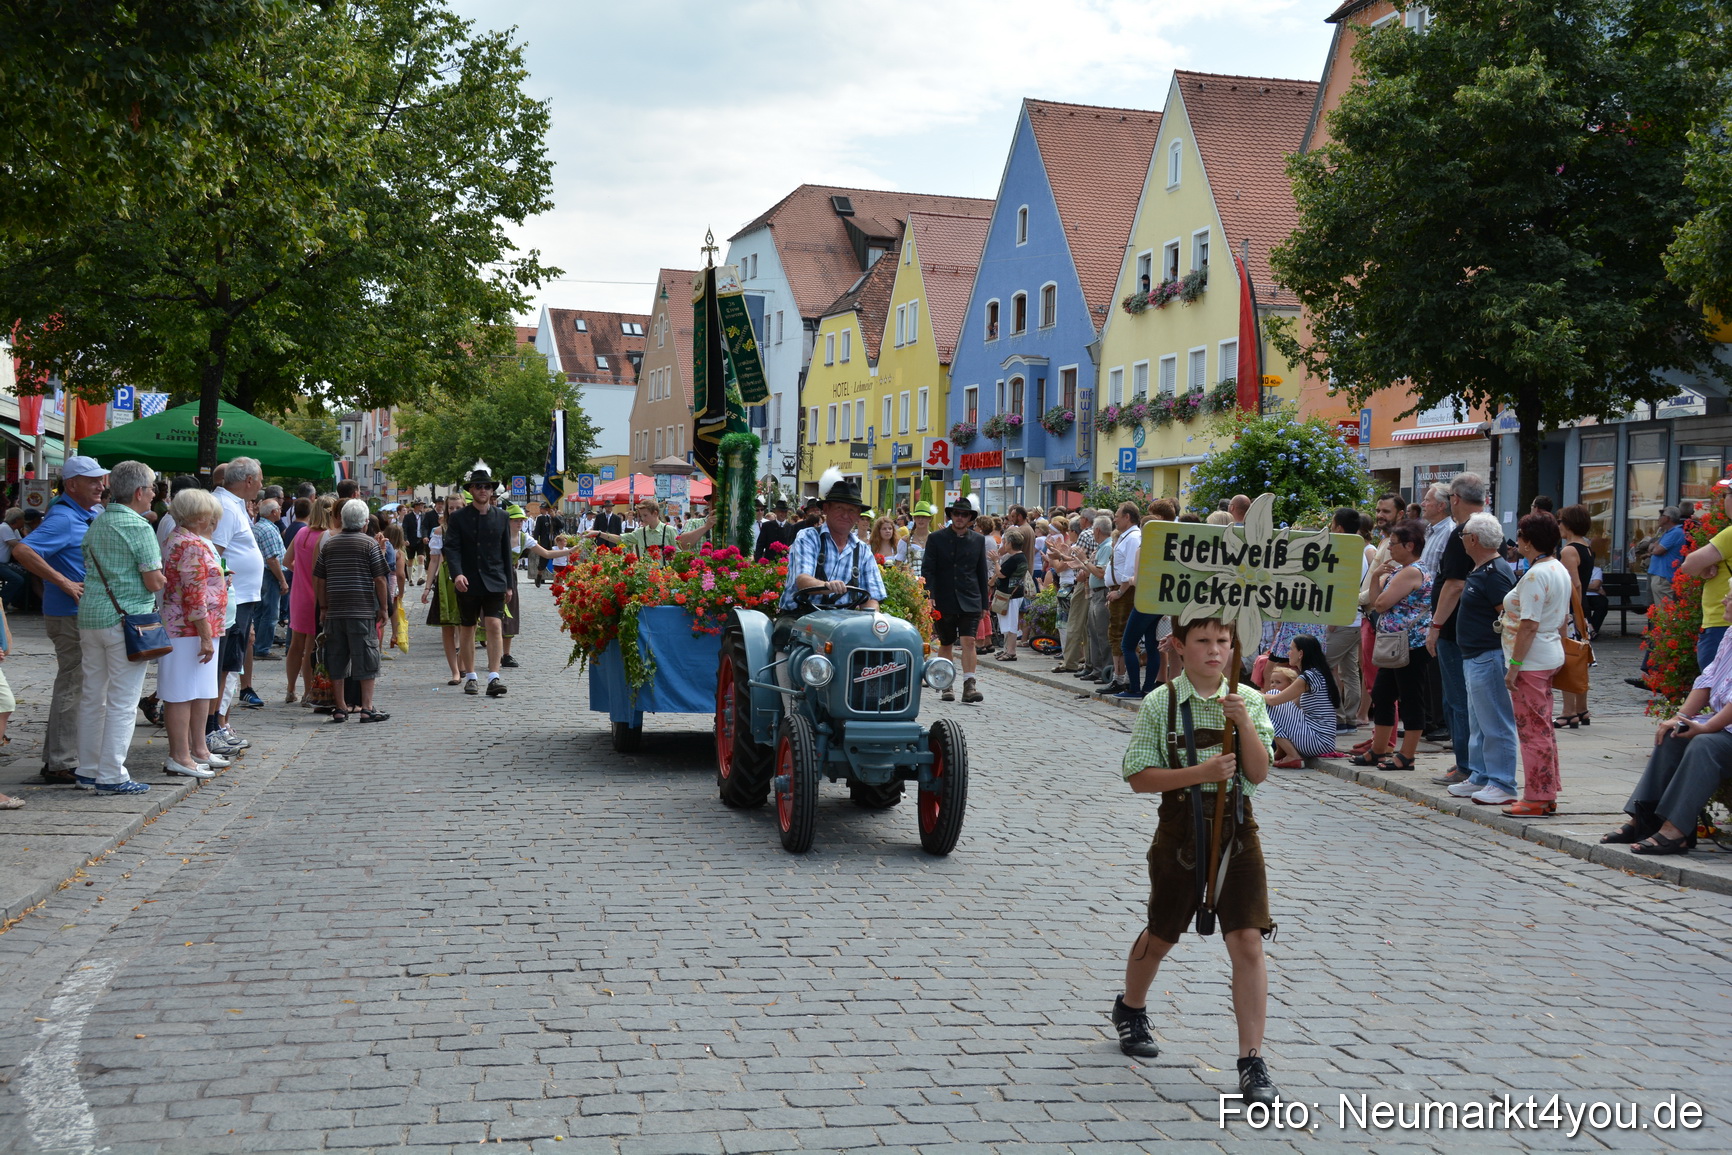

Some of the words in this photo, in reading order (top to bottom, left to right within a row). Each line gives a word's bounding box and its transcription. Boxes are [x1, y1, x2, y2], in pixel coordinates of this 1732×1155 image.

[118, 388, 129, 406] P
[832, 381, 850, 398] HOTEL
[853, 379, 874, 394] Lehmeier
[155, 433, 257, 447] Lambräu
[171, 428, 245, 438] Neukter
[959, 450, 1003, 470] APOTHEKE
[1123, 450, 1133, 471] P
[1163, 532, 1288, 569] Edelweiß
[1302, 542, 1340, 574] 64
[1158, 573, 1334, 613] Röckersbühl
[860, 662, 898, 677] Eicher
